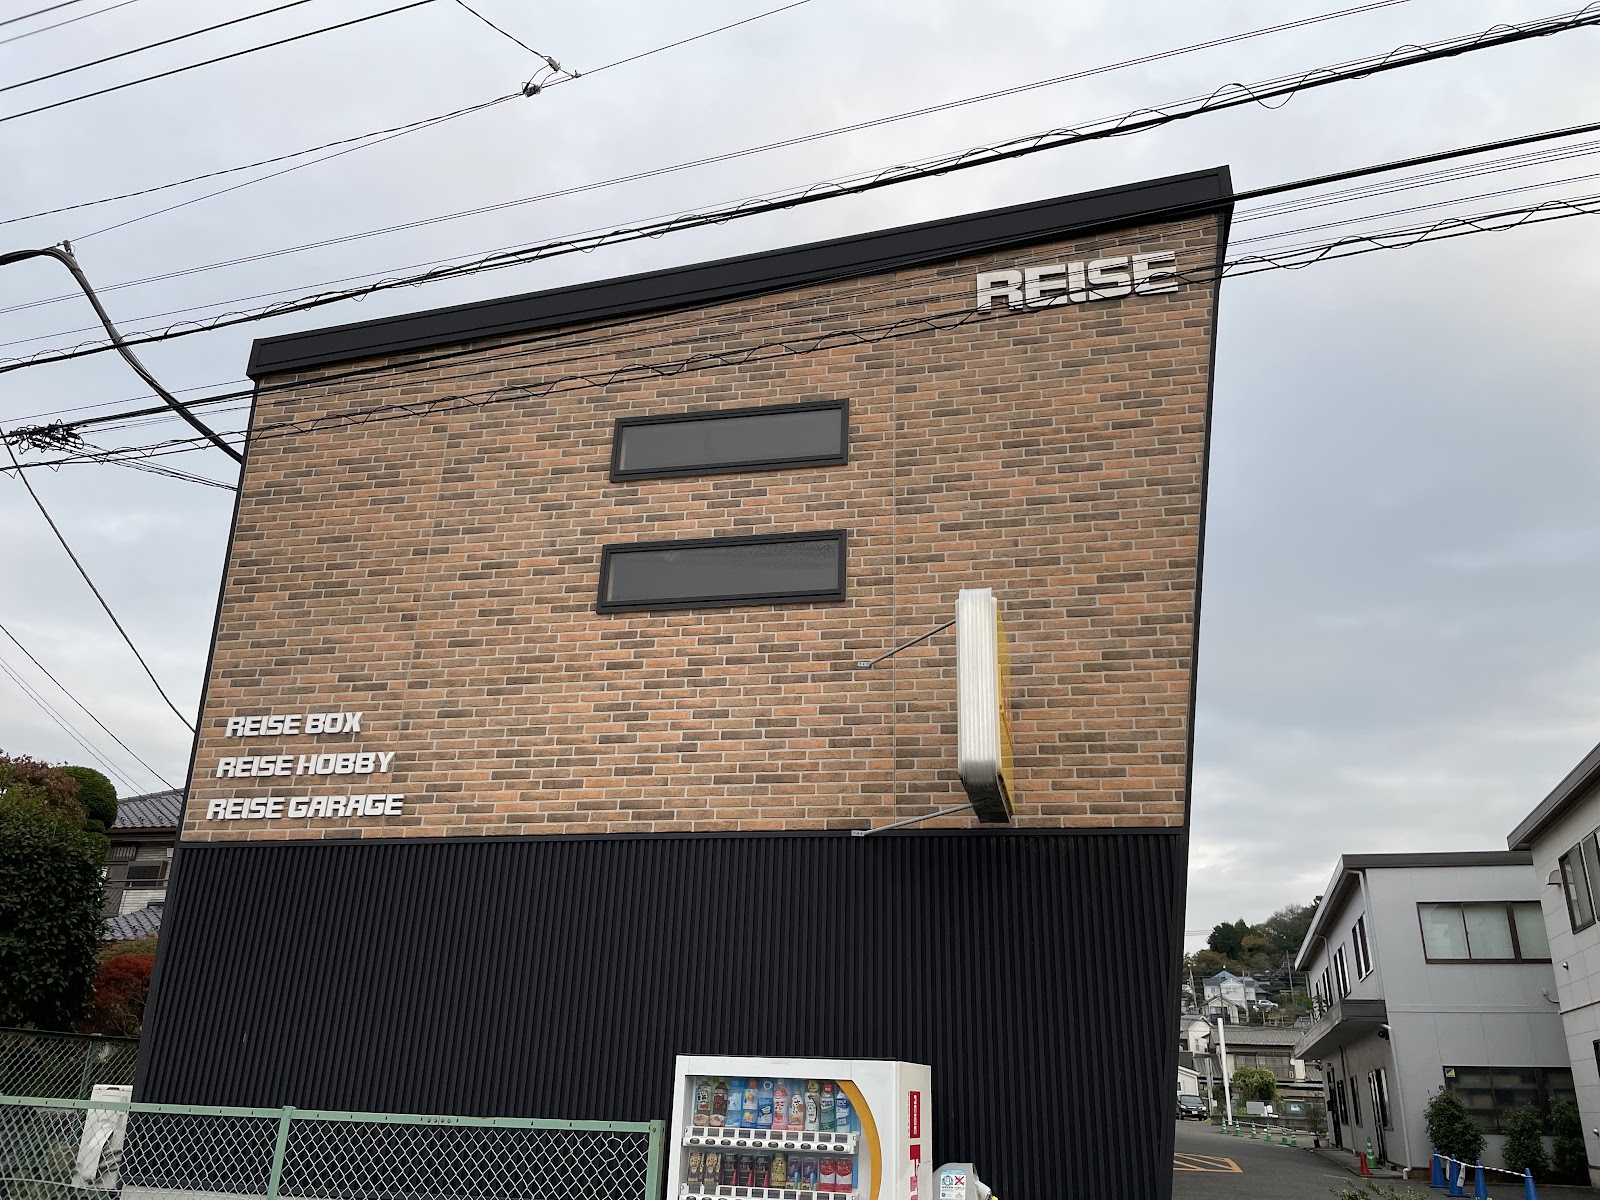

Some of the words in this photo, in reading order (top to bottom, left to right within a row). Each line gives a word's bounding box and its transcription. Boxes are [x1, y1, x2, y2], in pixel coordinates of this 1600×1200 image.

[976, 250, 1179, 314] REISE
[225, 715, 302, 737] REISE
[304, 712, 363, 734] BOX
[216, 755, 294, 778] REISE
[296, 751, 396, 775] HOBBY
[206, 797, 285, 820] REISE
[287, 793, 405, 818] GARAGE
